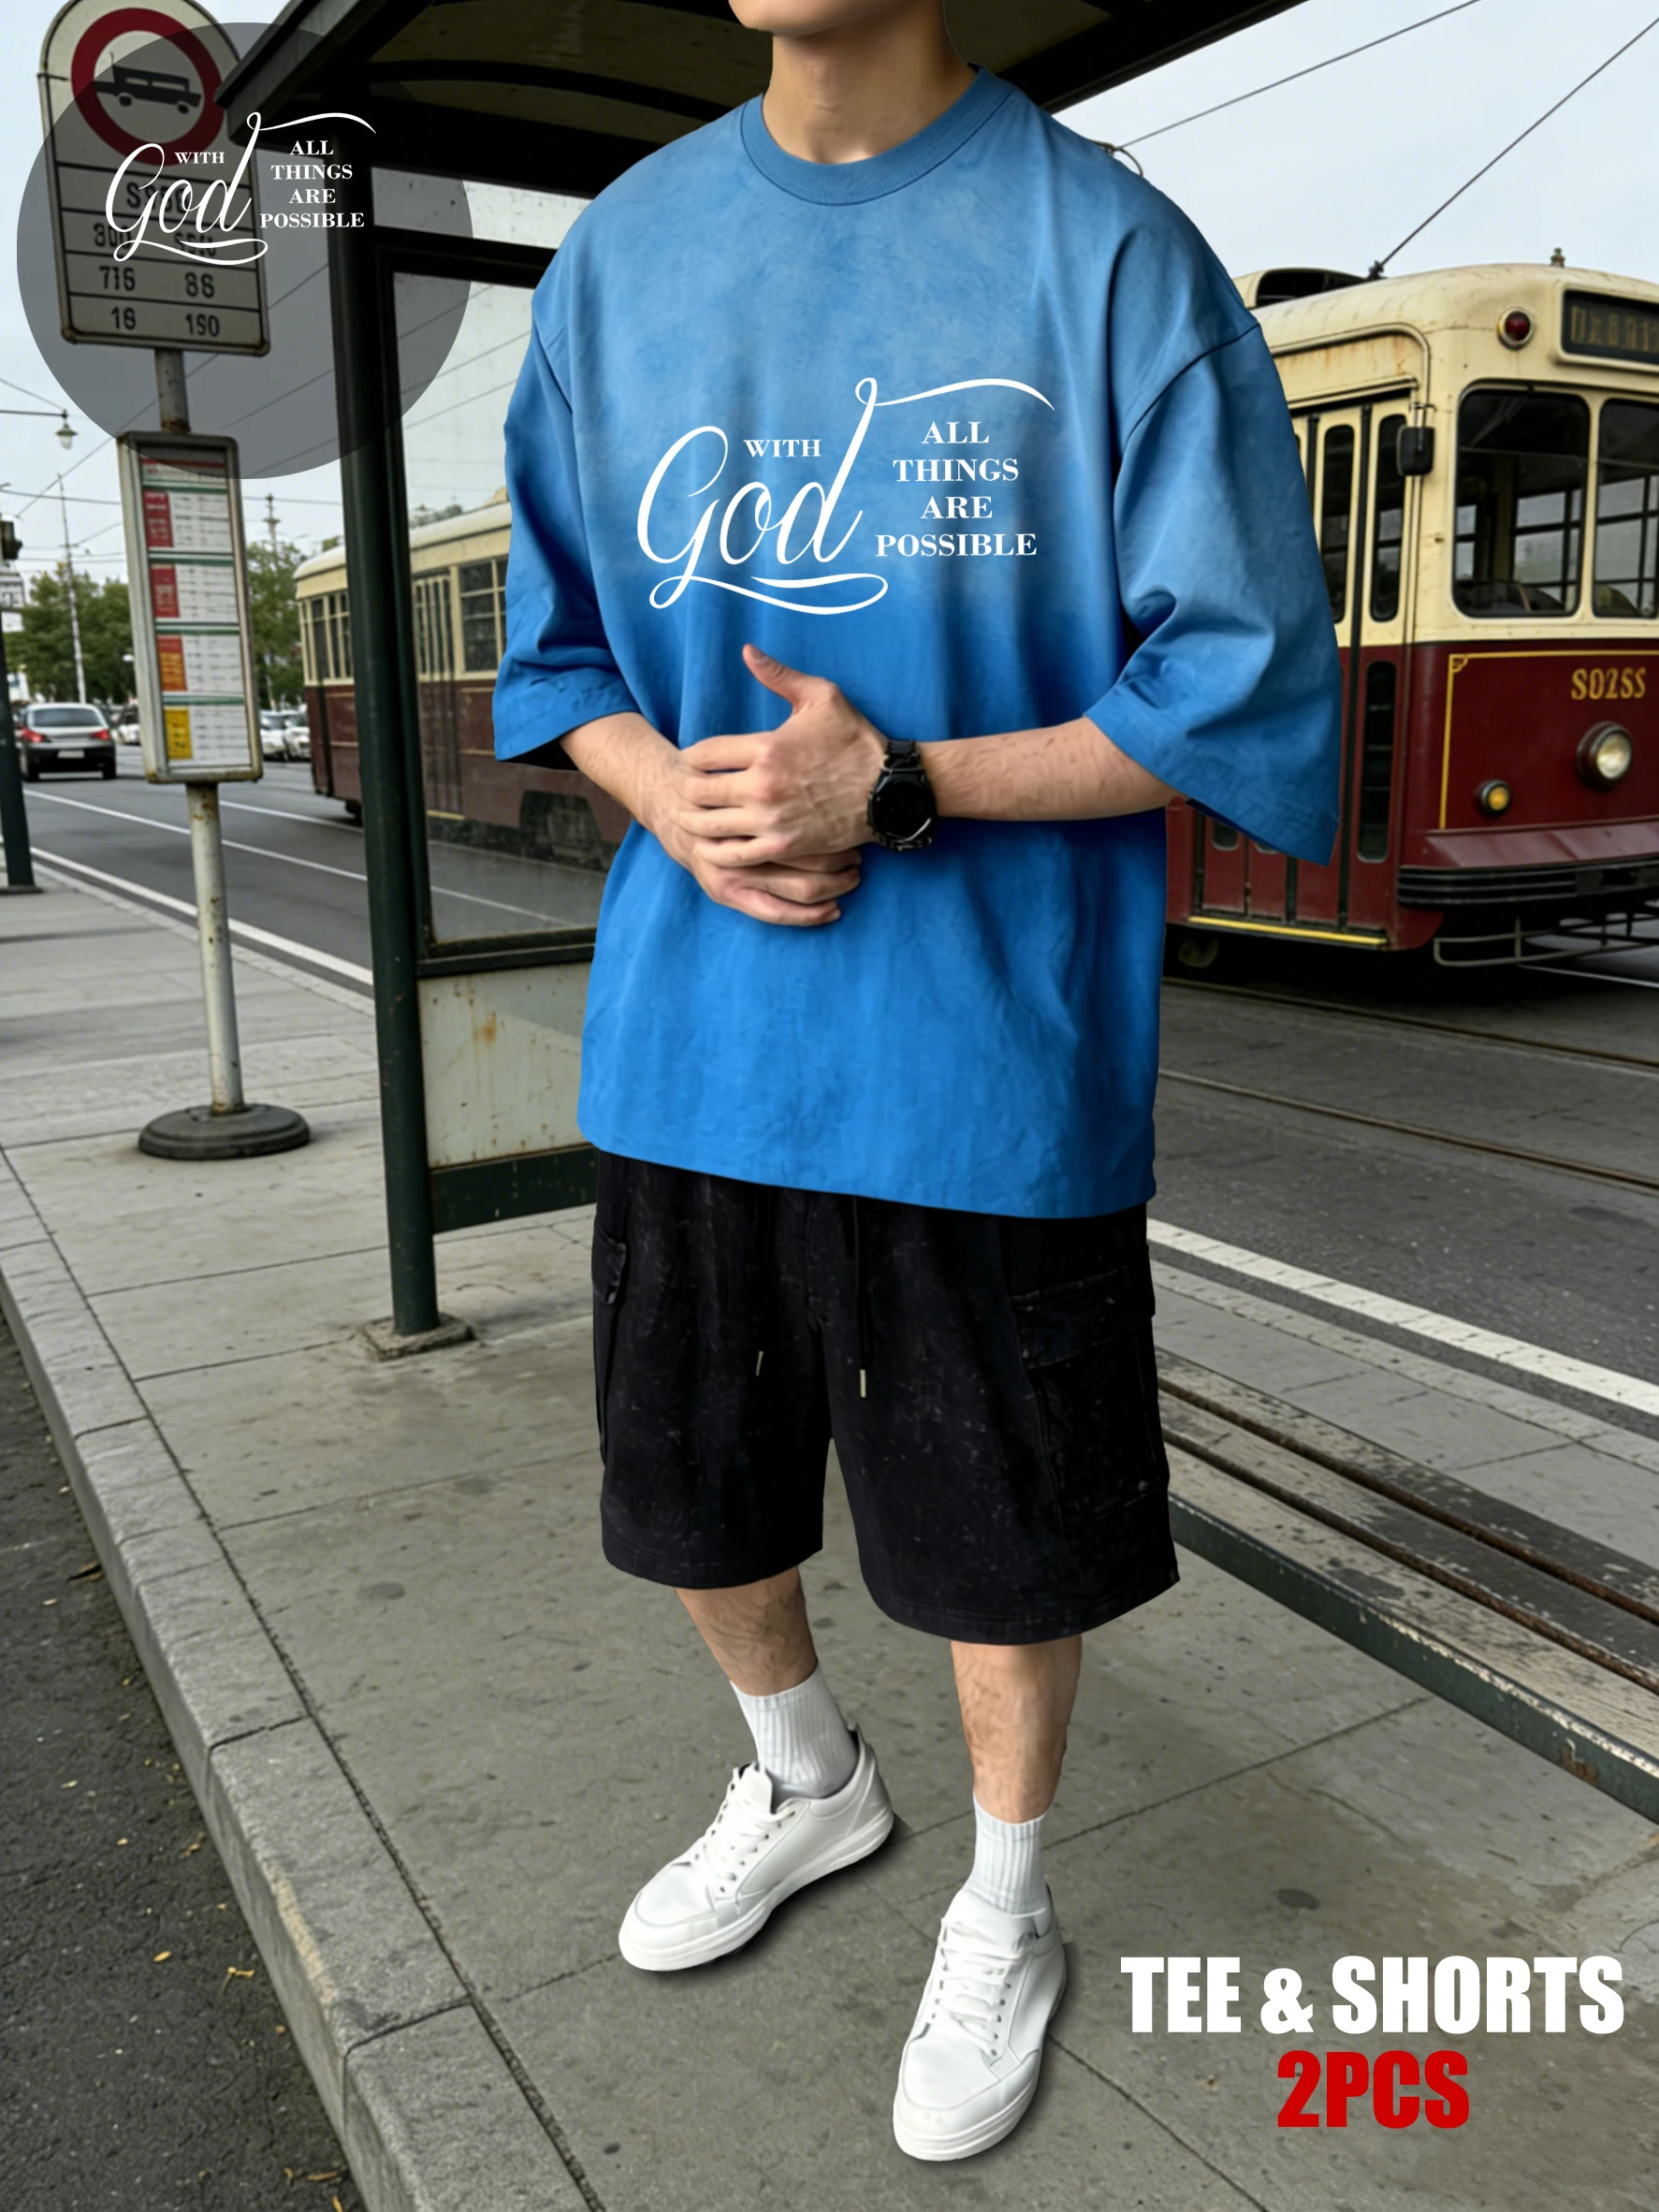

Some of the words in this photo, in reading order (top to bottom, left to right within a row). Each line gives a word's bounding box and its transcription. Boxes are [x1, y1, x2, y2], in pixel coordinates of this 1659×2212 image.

[921, 421, 990, 444] ALL
[744, 439, 822, 458] WITH
[893, 458, 1019, 482] THINGS
[920, 496, 993, 519] ARE
[875, 533, 1037, 558] POSSIBLE
